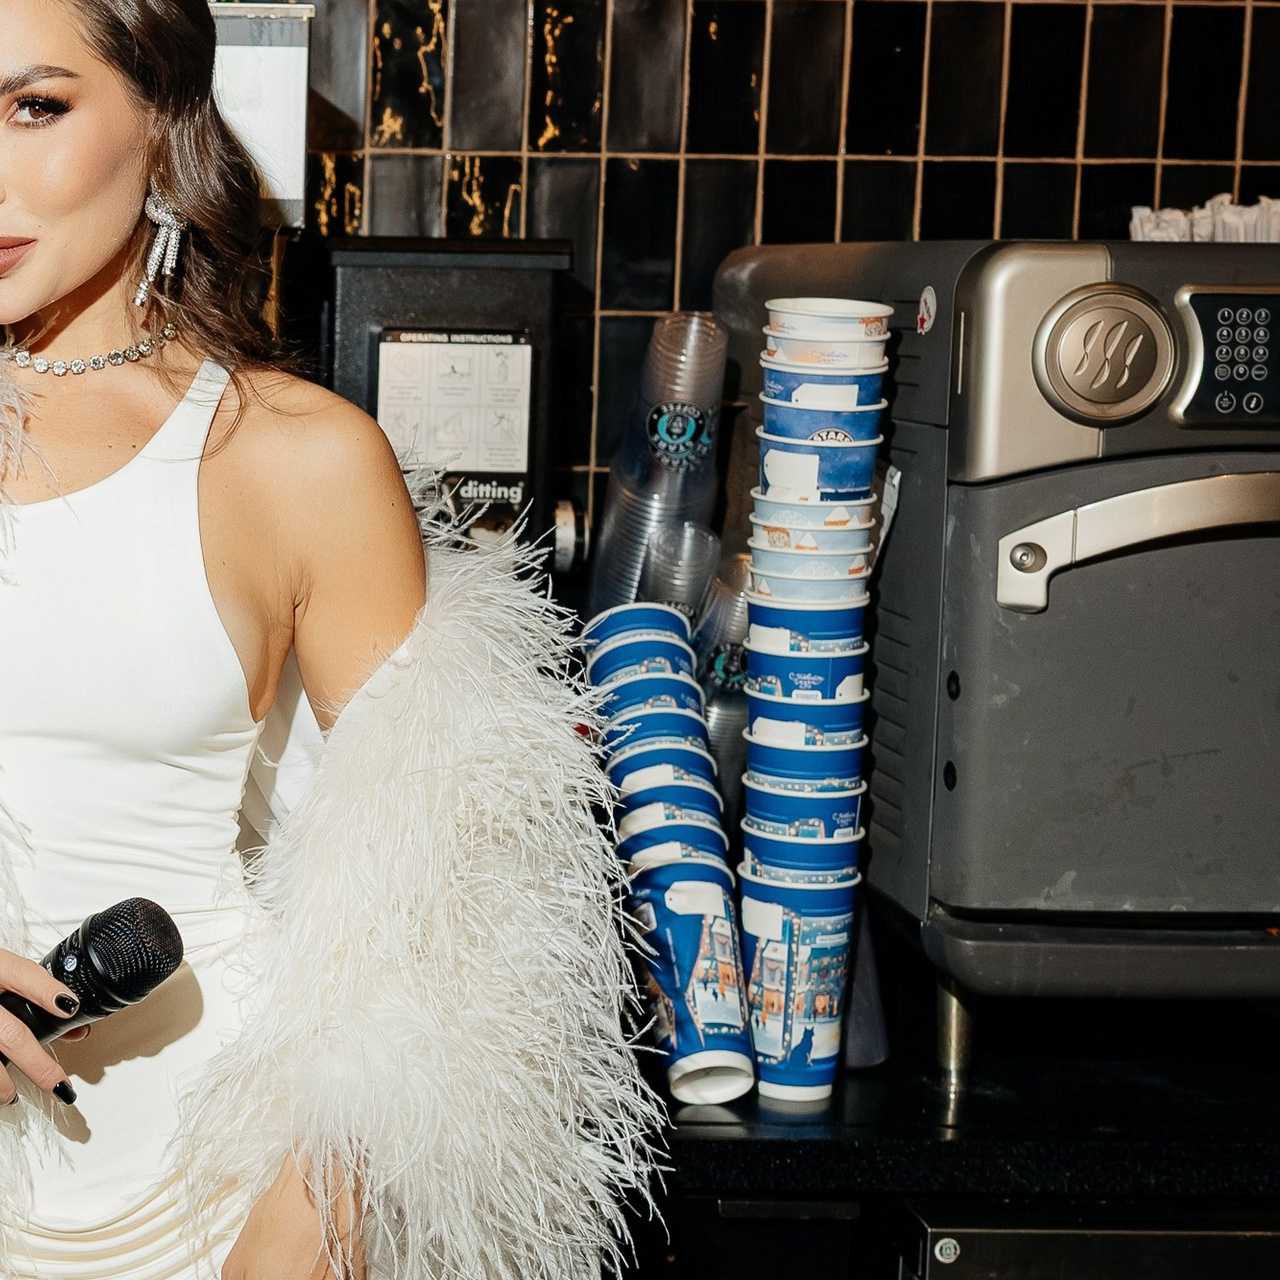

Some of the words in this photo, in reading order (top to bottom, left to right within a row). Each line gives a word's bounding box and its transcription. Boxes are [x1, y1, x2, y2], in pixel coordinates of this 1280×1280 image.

[400, 333, 449, 342] OPERATING
[451, 333, 513, 344] INSTRUCTIONS
[459, 480, 522, 504] ditting
